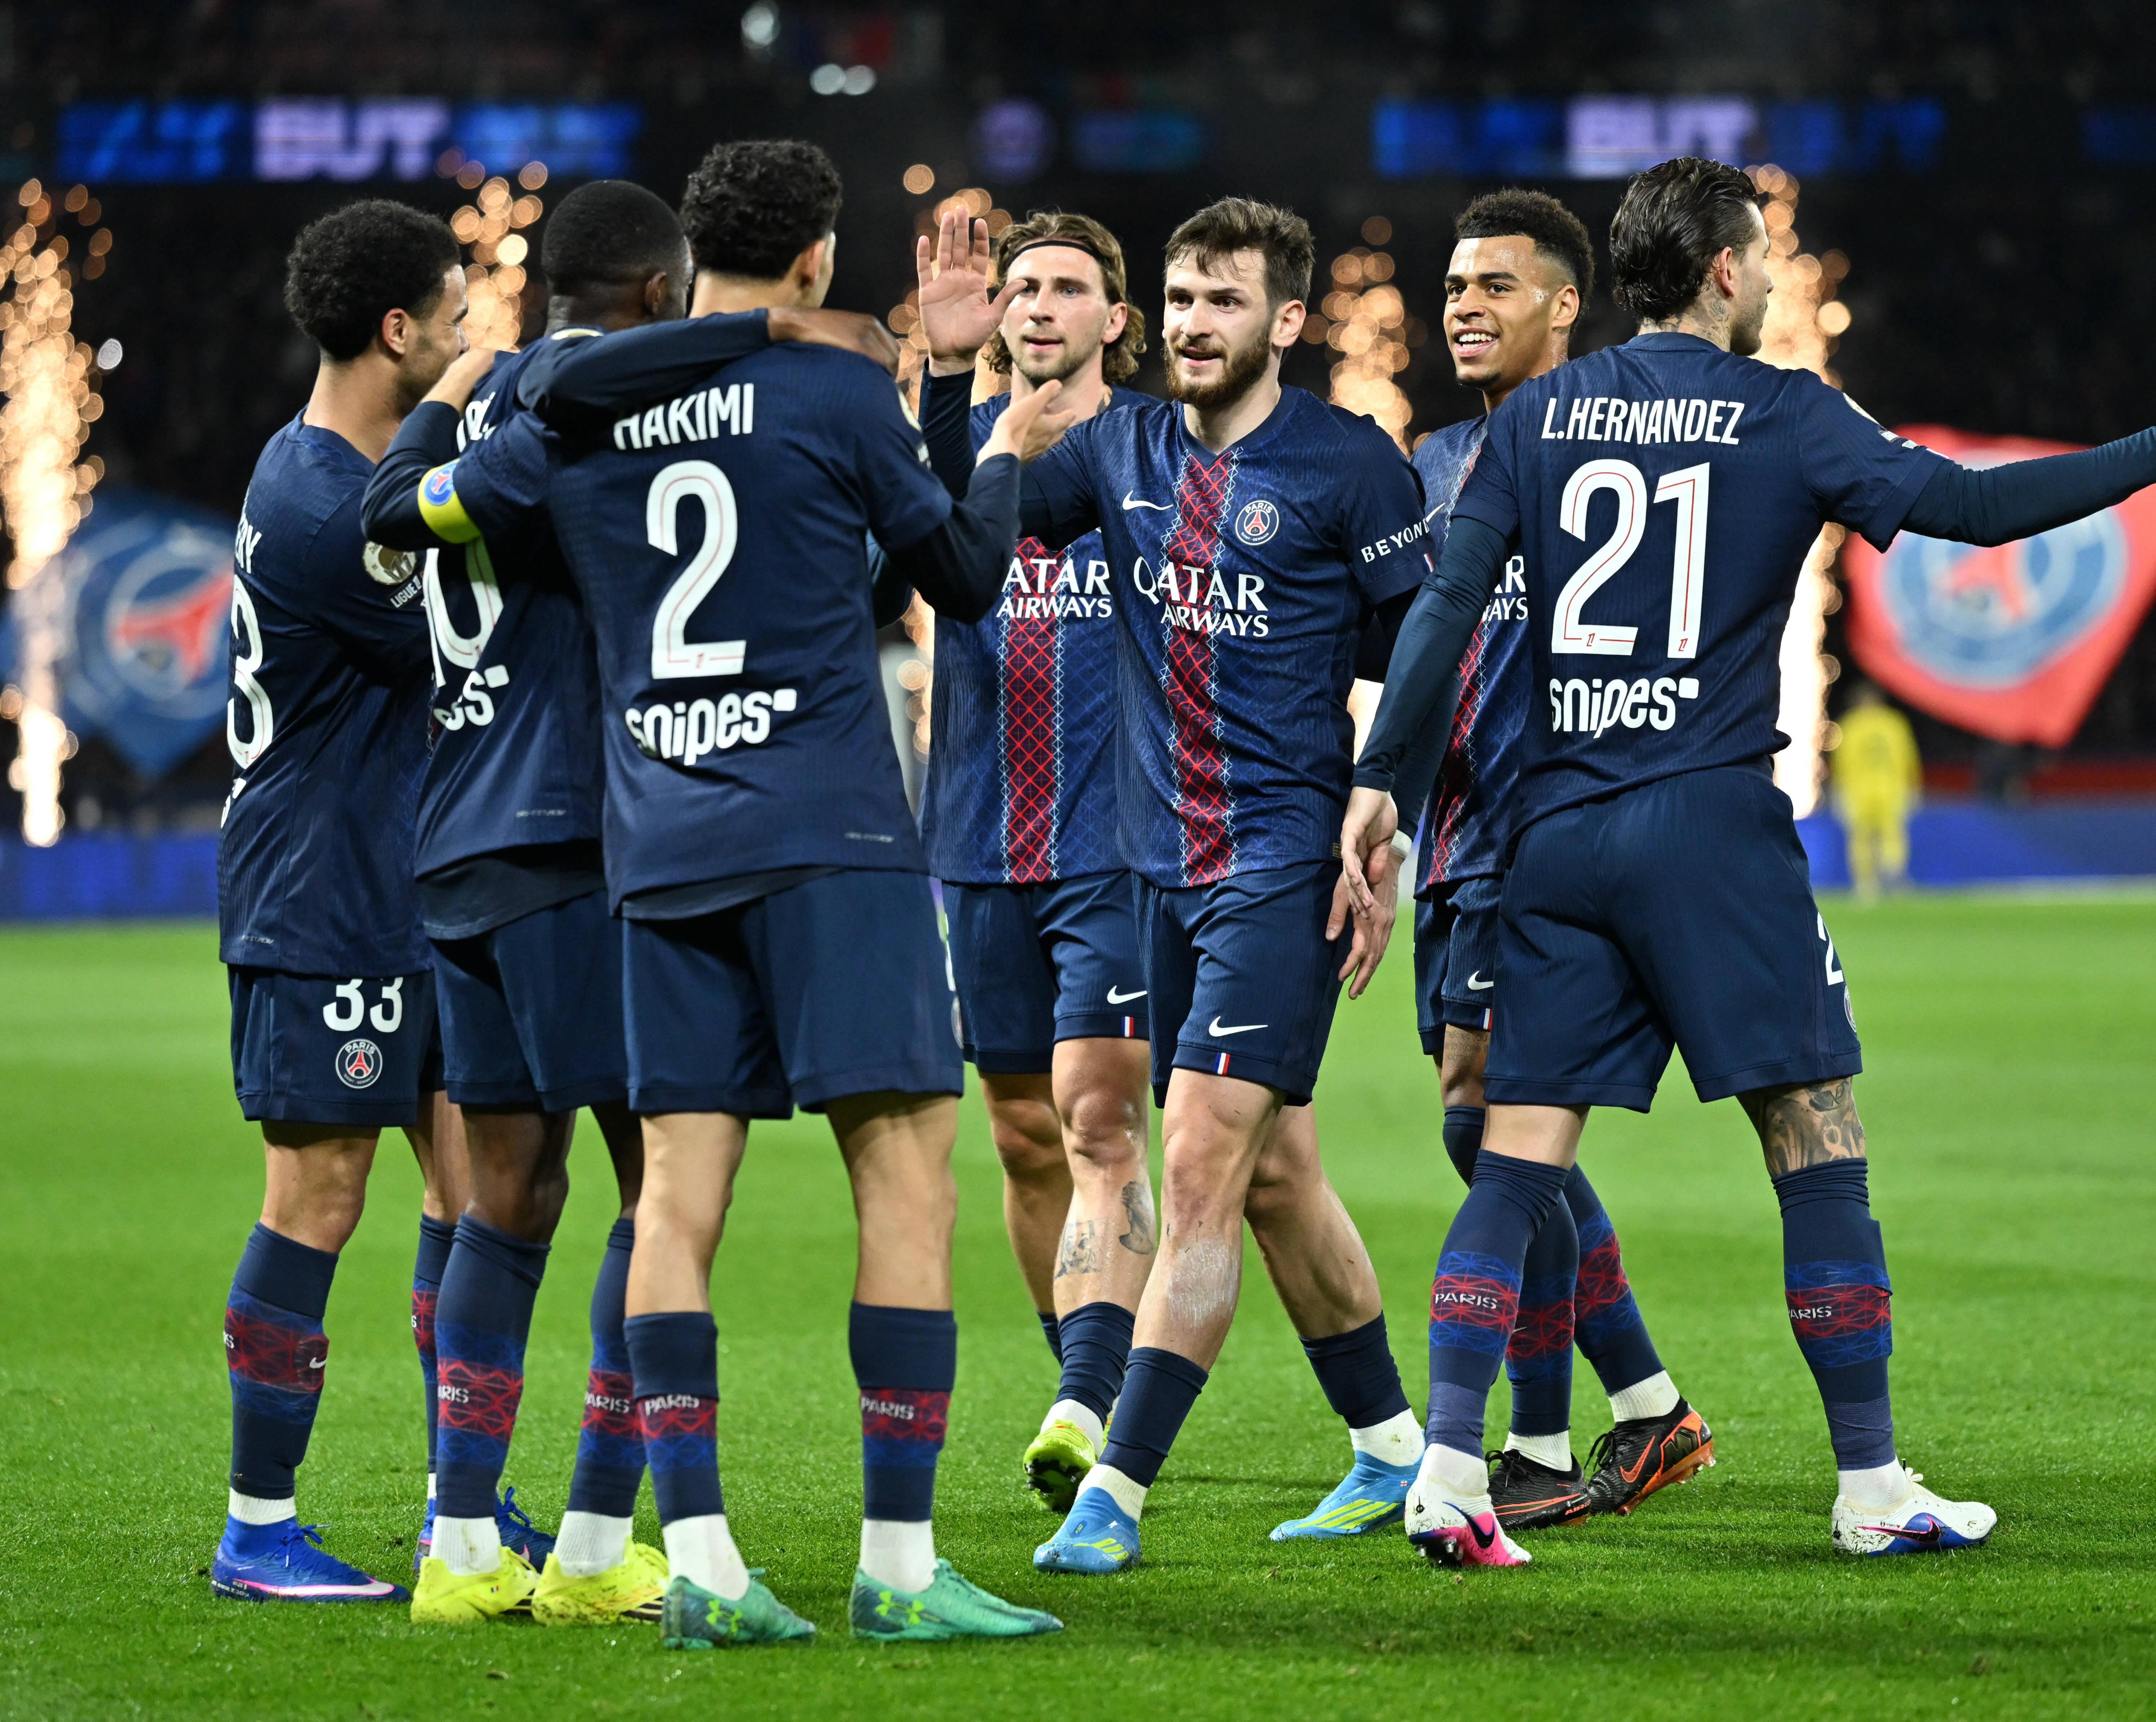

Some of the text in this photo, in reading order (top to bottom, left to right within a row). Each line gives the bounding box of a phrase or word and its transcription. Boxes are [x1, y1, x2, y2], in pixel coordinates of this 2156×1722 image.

[252, 97, 450, 180] BUT
[614, 383, 754, 450] HAKIMI
[1541, 397, 1744, 445] L.HERNANDEZ
[1245, 502, 1273, 514] PARIS
[1361, 518, 1430, 563] BEYOND
[1552, 459, 1710, 659] 21
[646, 460, 746, 679] 2
[1001, 558, 1111, 595] ATAR
[1133, 556, 1268, 611] QATAR
[996, 596, 1112, 618] AIRWAYS
[1160, 603, 1269, 637] AIRWAYS
[625, 689, 774, 766] snipes
[1549, 677, 1677, 739] snipes
[323, 977, 403, 1032] 33
[344, 1041, 376, 1054] PARIS
[1435, 1292, 1498, 1310] PARIS
[1788, 1305, 1832, 1319] ARIS
[861, 1396, 915, 1420] PARIS
